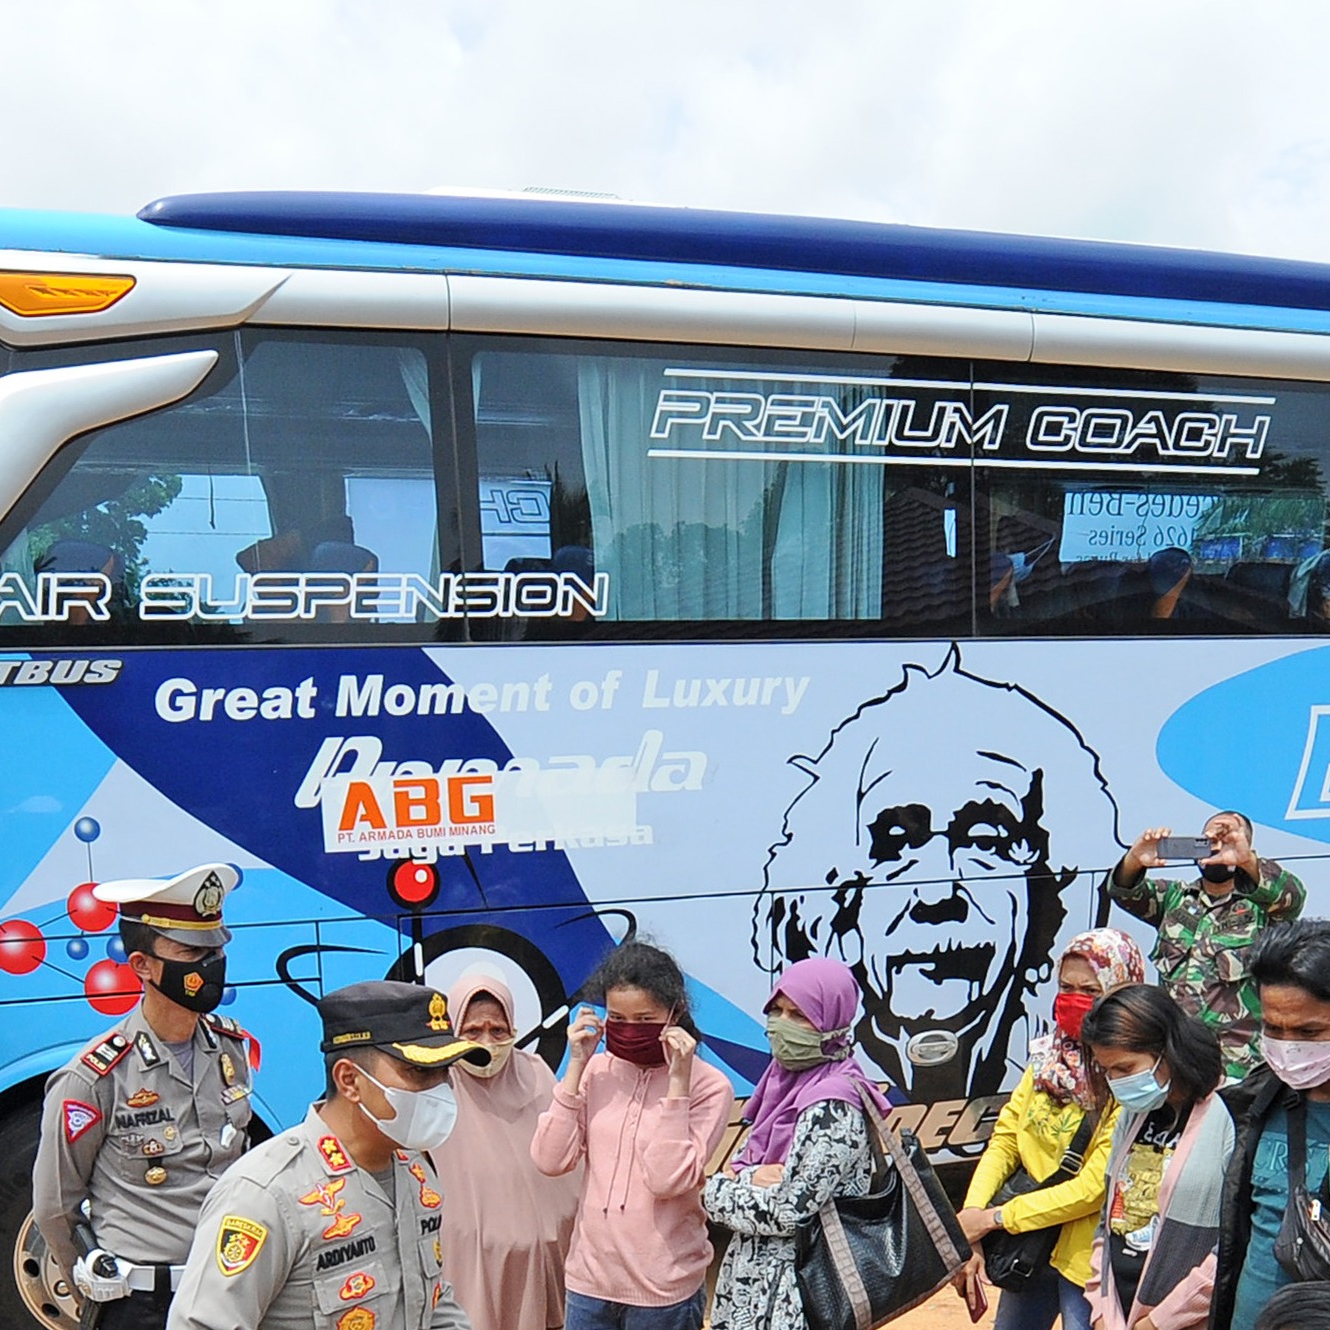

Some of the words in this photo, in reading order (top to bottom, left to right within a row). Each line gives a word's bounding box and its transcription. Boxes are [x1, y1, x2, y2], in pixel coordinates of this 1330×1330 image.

[651, 389, 1008, 449] PREMIUM
[1026, 407, 1271, 459] COACH
[140, 572, 610, 621] SUSPENSION
[155, 676, 316, 723] Great
[335, 671, 559, 717] Moment
[570, 670, 621, 711] of
[642, 674, 811, 716] Luxury
[338, 775, 496, 832] ABG
[337, 833, 356, 843] PT.
[359, 829, 414, 842] ARMADA
[417, 827, 446, 839] BUMI
[449, 824, 497, 837] MINANG
